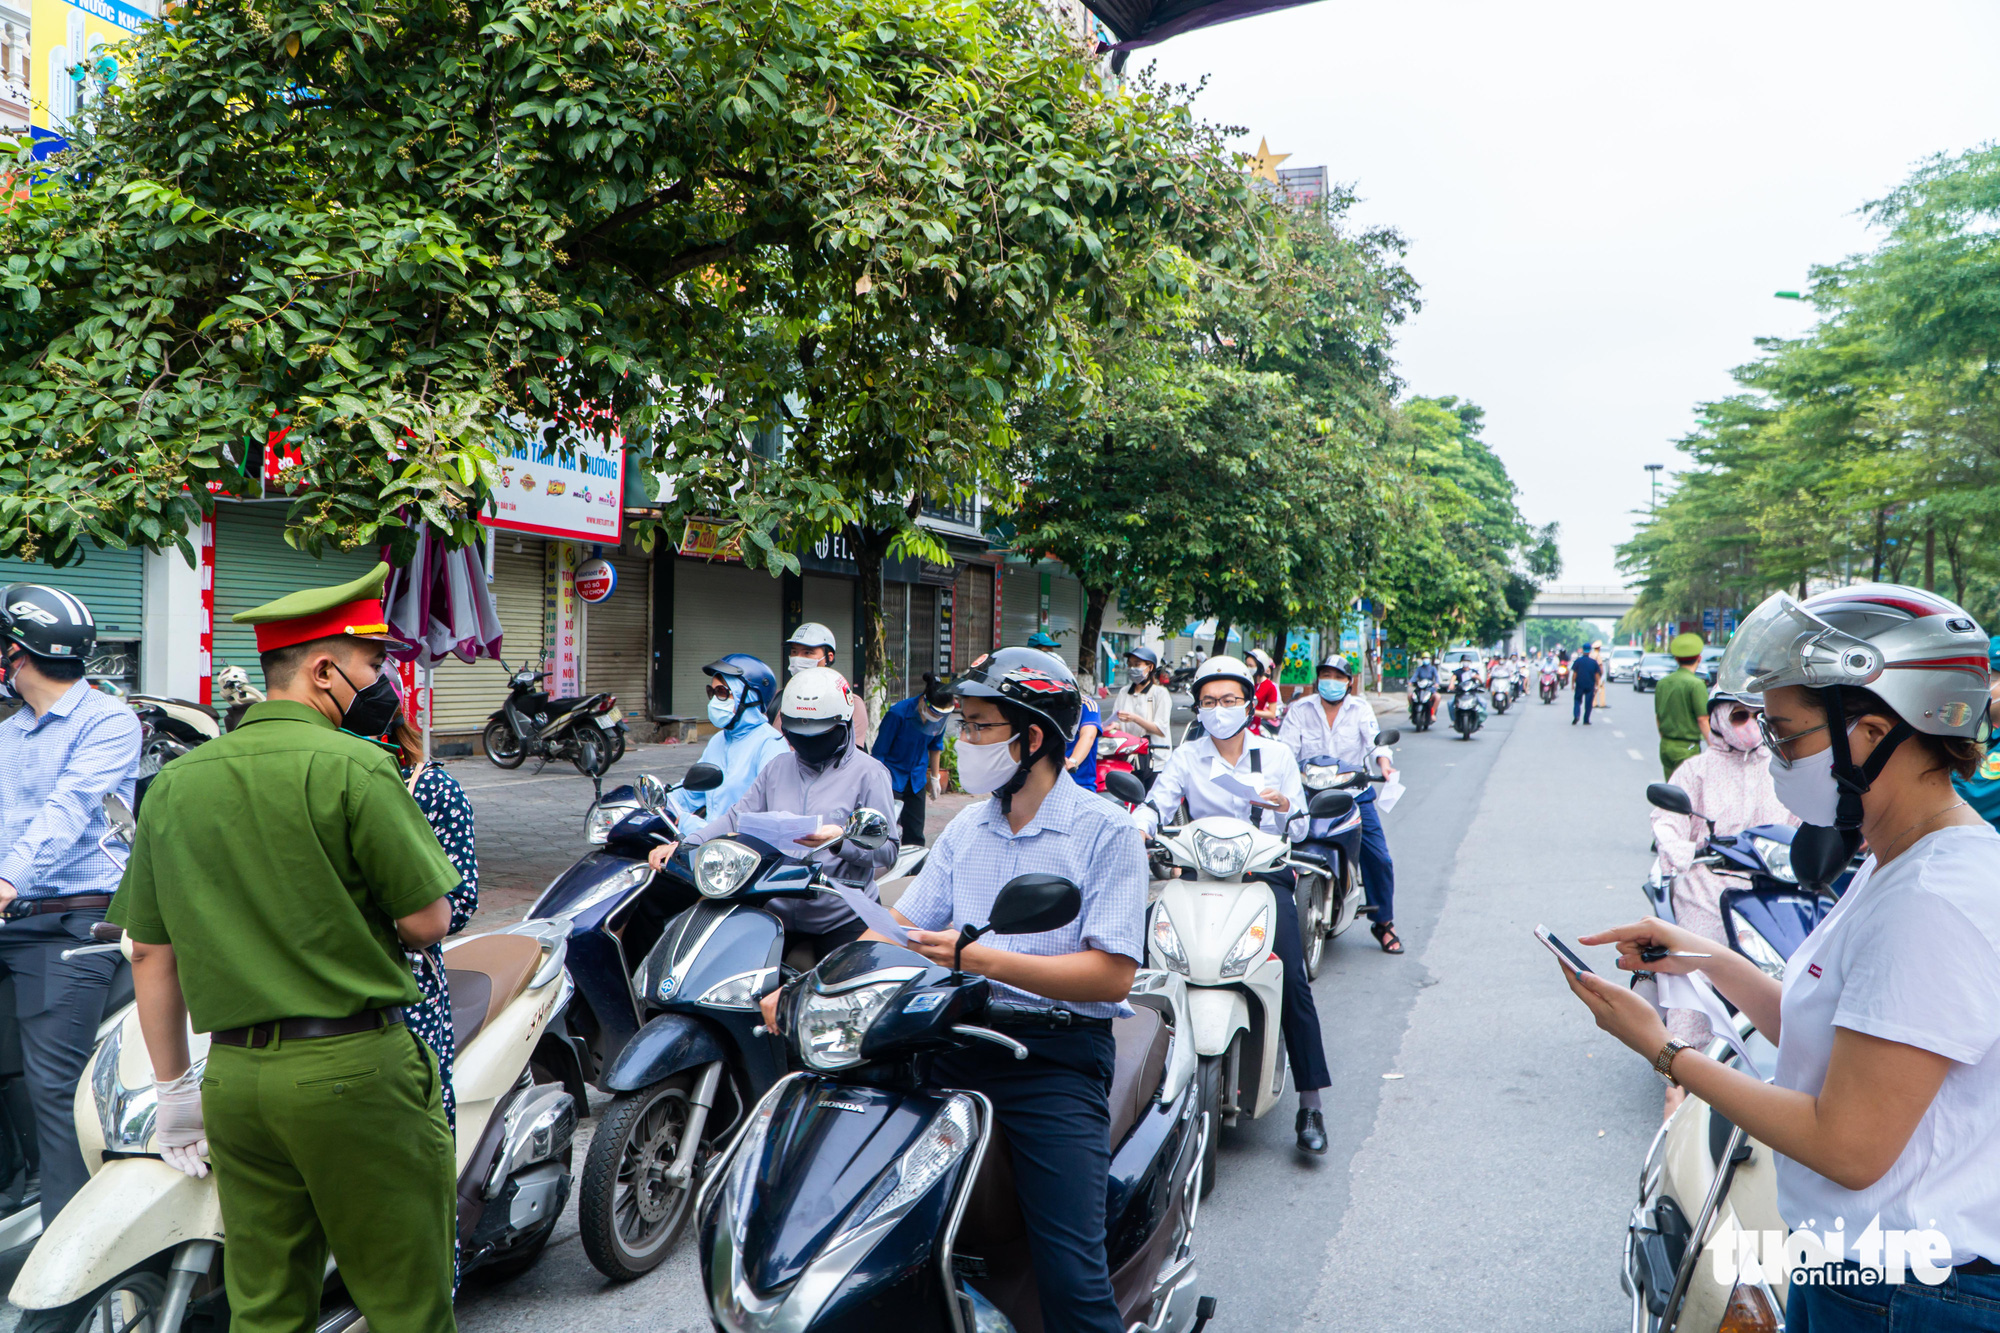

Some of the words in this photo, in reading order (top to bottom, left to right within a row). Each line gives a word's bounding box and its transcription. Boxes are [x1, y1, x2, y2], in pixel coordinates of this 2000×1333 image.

[580, 450, 617, 479] HƯỞNG
[8, 601, 59, 628] GP
[564, 633, 573, 646] SỐ
[564, 651, 573, 662] HÀ
[563, 667, 574, 678] NỘI
[817, 1100, 865, 1114] HONDA
